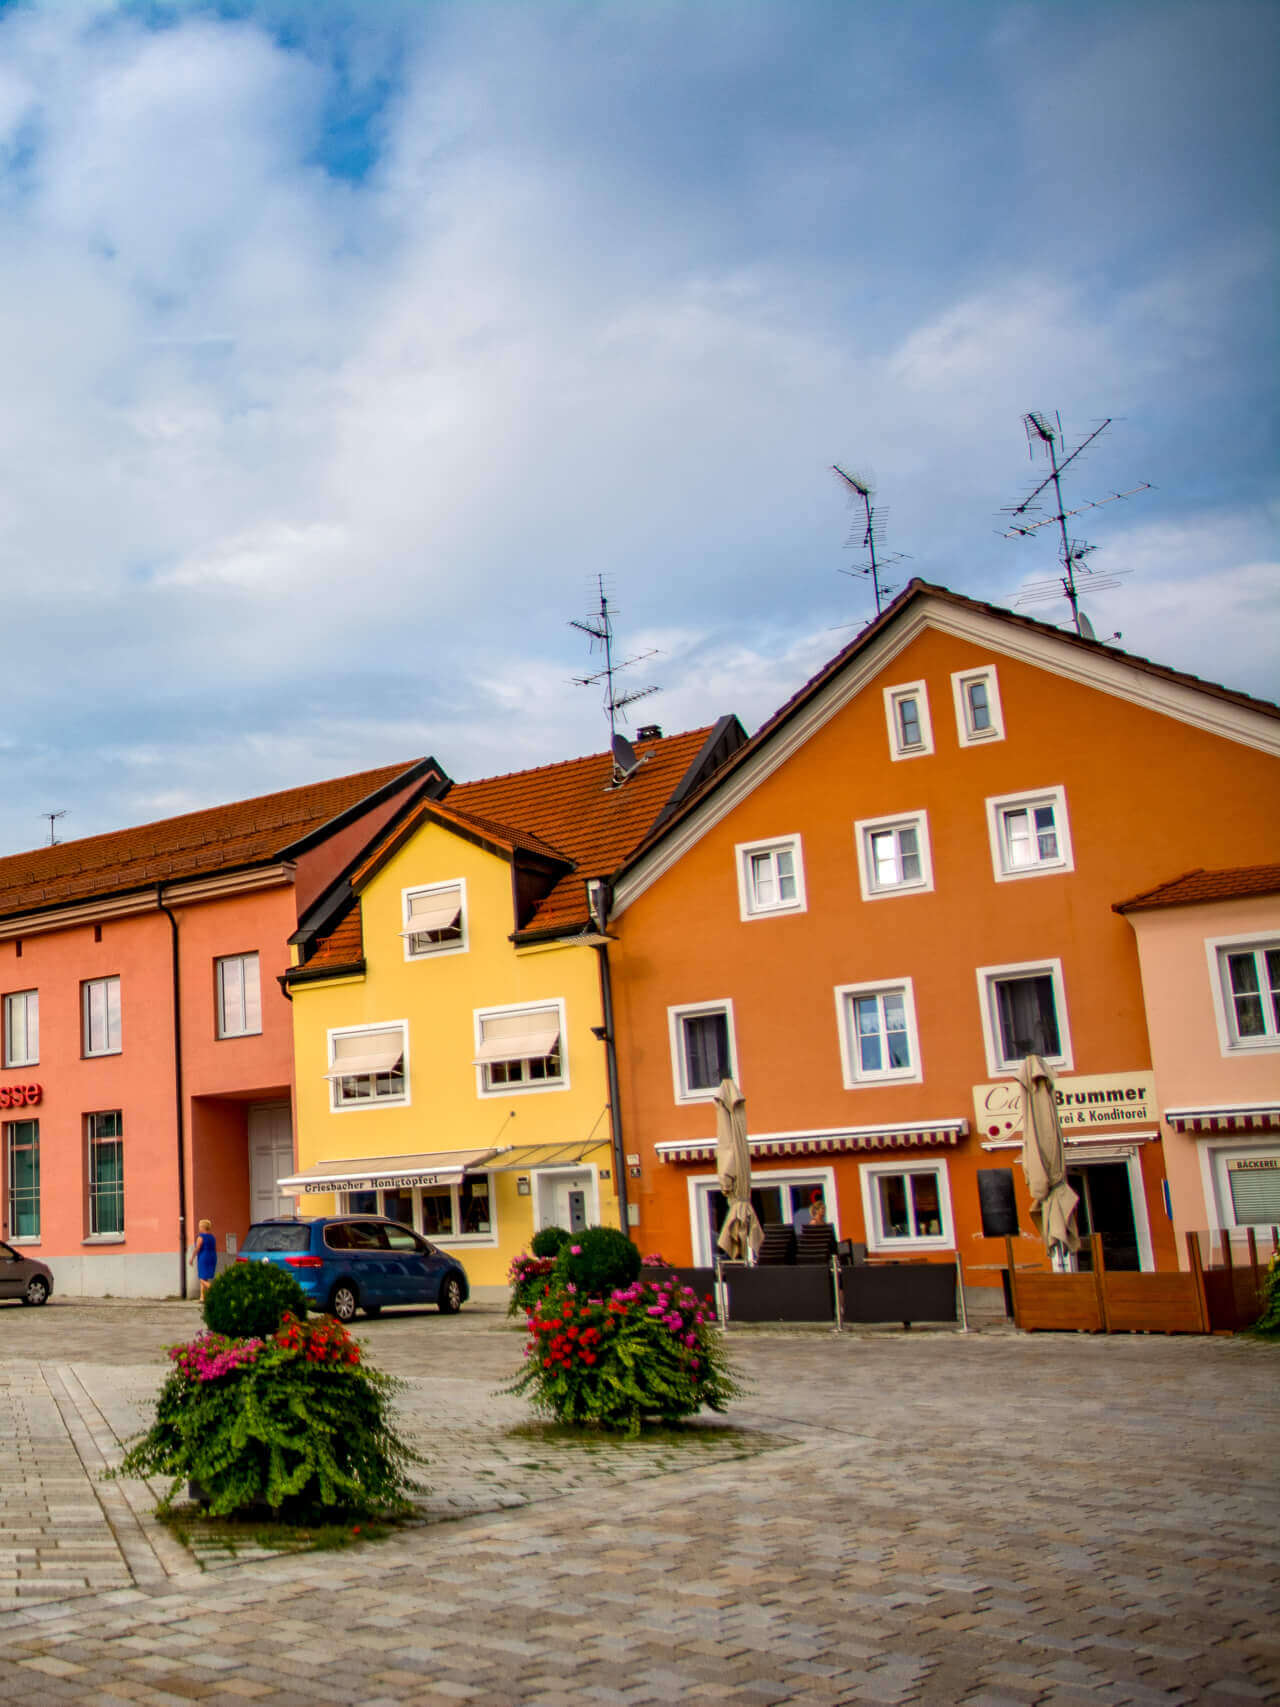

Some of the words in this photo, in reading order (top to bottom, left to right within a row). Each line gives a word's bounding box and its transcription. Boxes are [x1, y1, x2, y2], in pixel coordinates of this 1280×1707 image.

[1055, 1086, 1147, 1106] Brummer
[1077, 1111, 1086, 1123] &
[1089, 1106, 1148, 1122] Konditorei
[304, 1181, 365, 1193] Griesbacher
